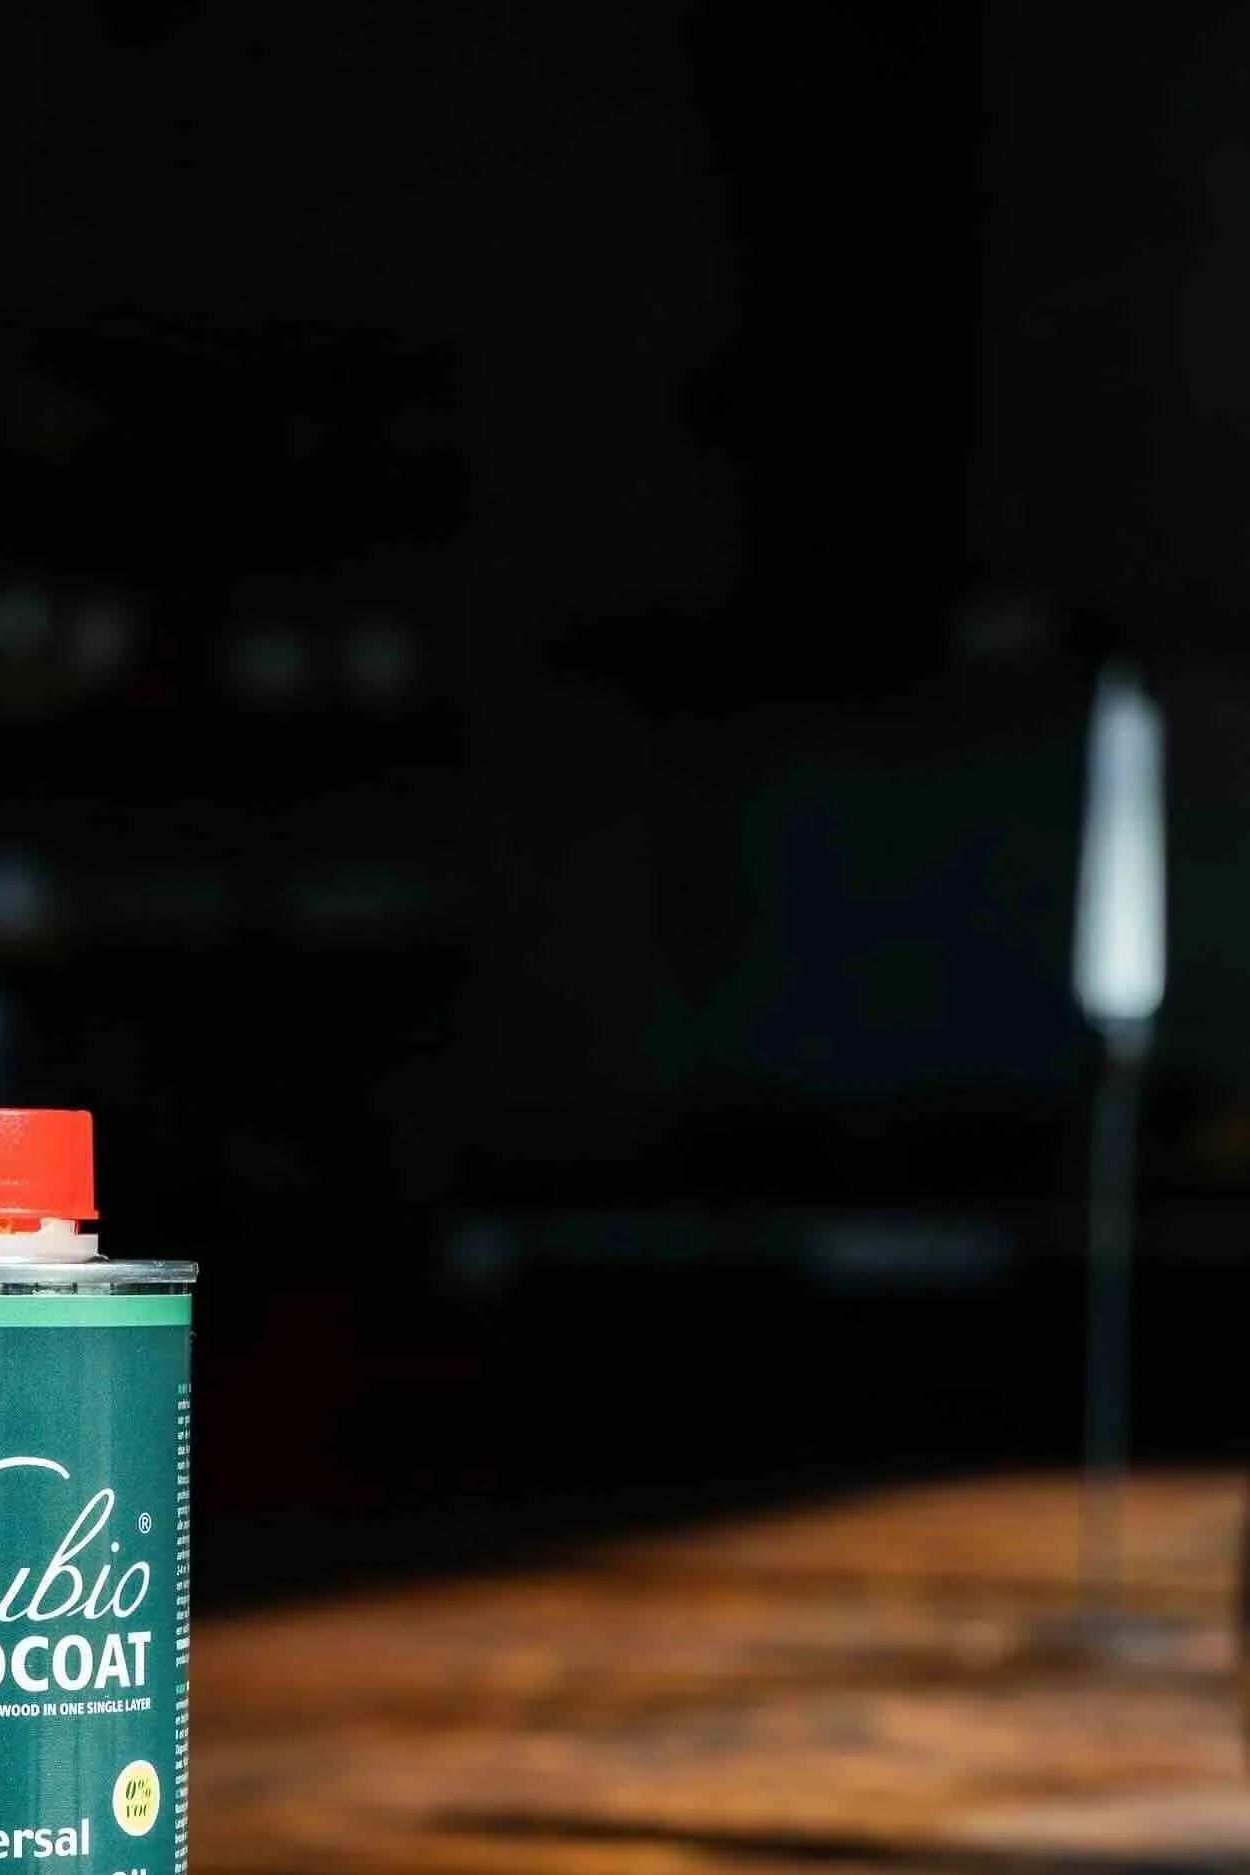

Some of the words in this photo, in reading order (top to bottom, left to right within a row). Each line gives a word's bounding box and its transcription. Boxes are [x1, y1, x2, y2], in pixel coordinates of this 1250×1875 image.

[0, 1704, 40, 1717] WOOD
[43, 1703, 57, 1716] IN
[60, 1702, 85, 1715] ONE
[87, 1699, 124, 1714] SINGLE
[125, 1697, 151, 1711] LAYER
[125, 1778, 152, 1801] 0%
